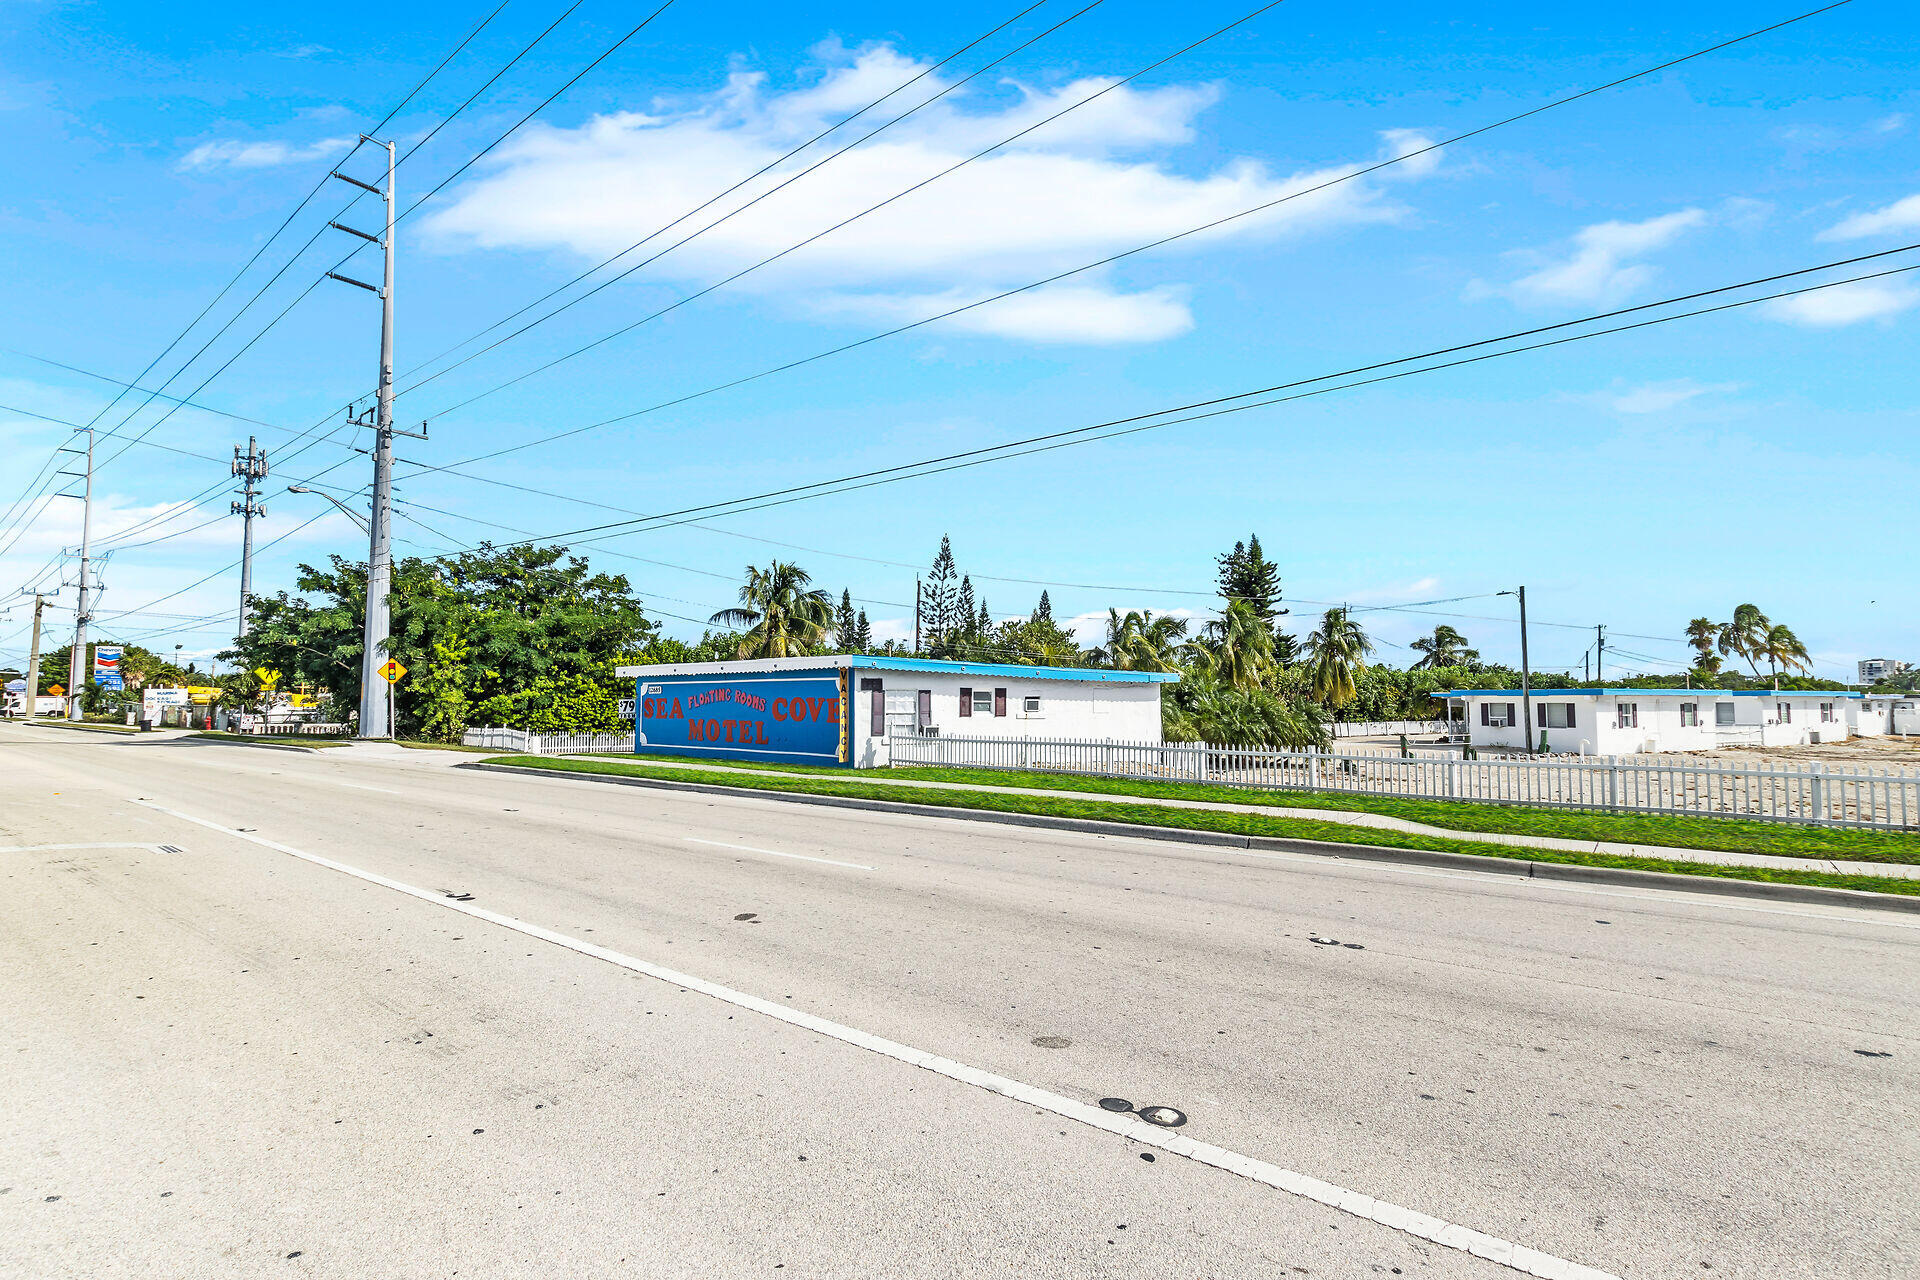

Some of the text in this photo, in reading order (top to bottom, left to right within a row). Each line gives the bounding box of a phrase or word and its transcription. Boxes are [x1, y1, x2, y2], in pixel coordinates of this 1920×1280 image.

[619, 700, 636, 713] $79
[643, 697, 841, 724] SEA COVE
[688, 688, 767, 712] FLOATING ROOMS
[840, 670, 848, 760] VACANCY
[687, 718, 769, 745] MOTEL
